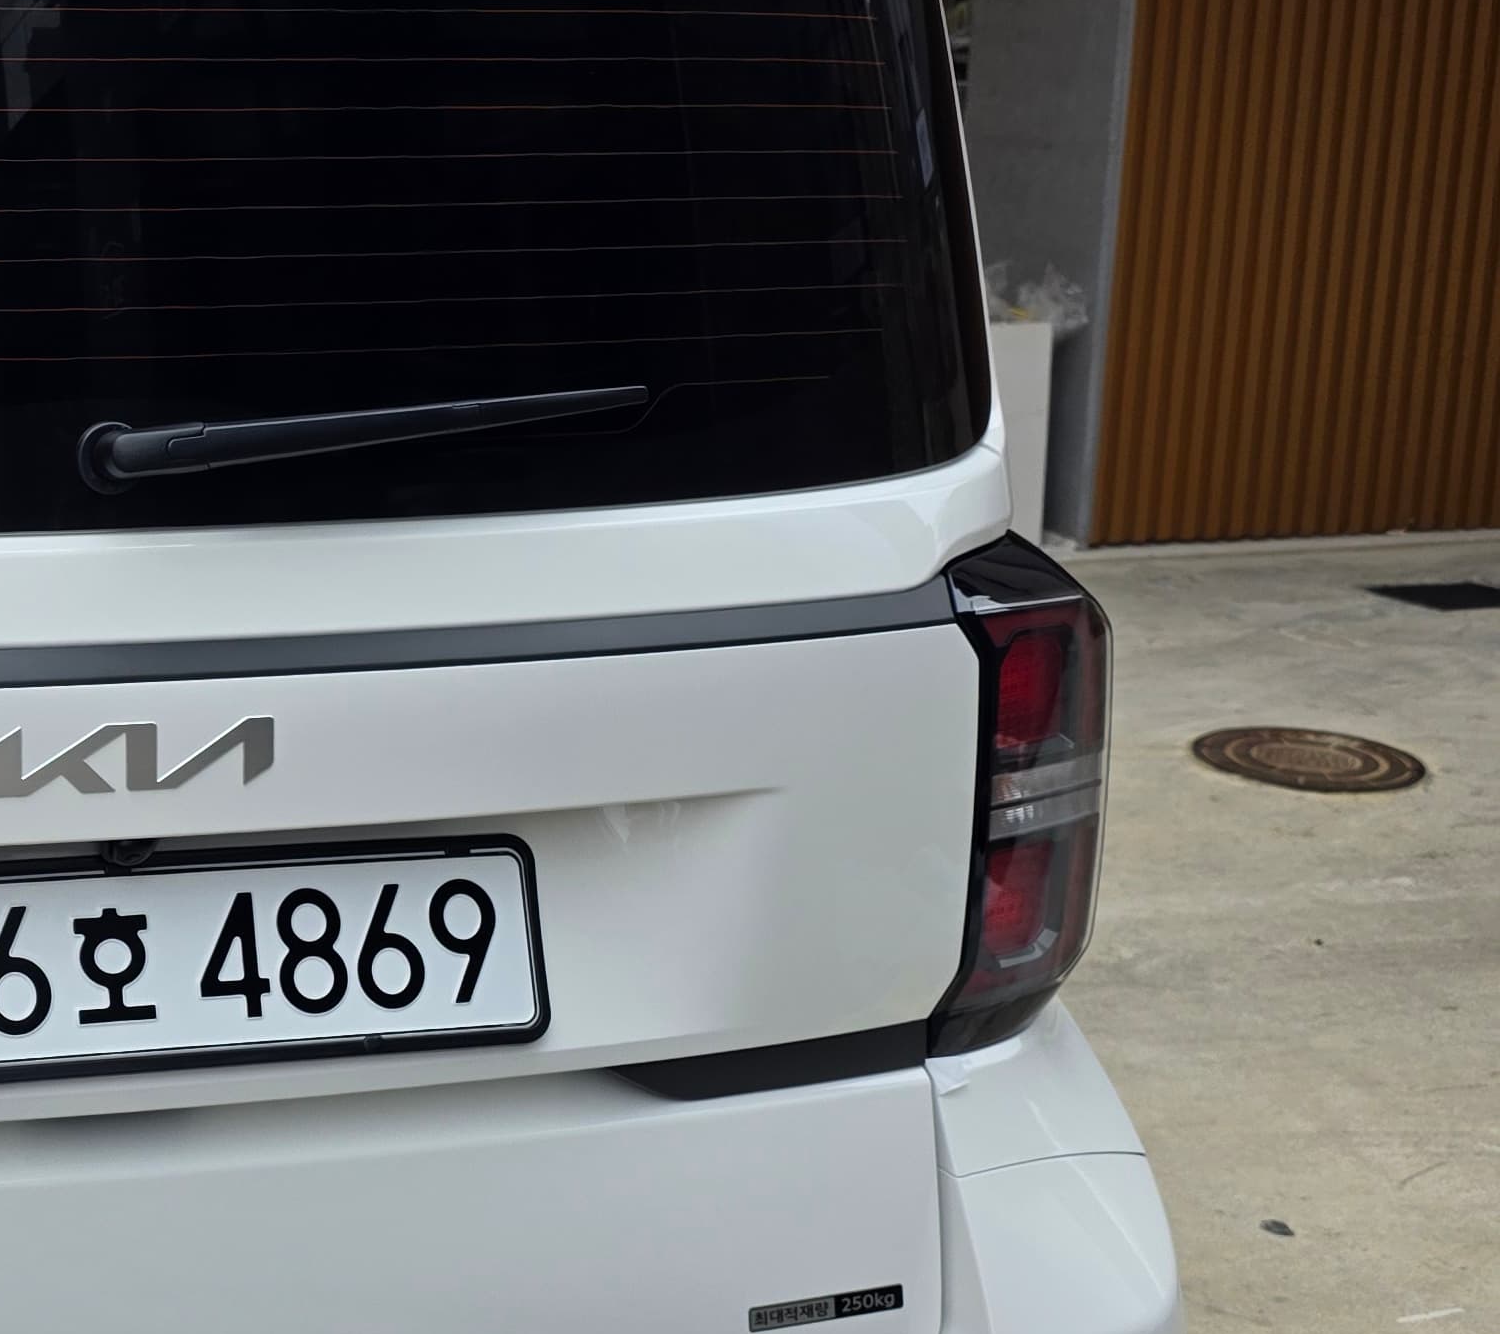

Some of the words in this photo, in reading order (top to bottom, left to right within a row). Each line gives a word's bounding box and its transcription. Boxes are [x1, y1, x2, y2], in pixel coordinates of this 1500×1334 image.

[199, 877, 497, 1019] 4869
[754, 1301, 829, 1326] 최대적재량
[841, 1292, 895, 1312] 250kg
